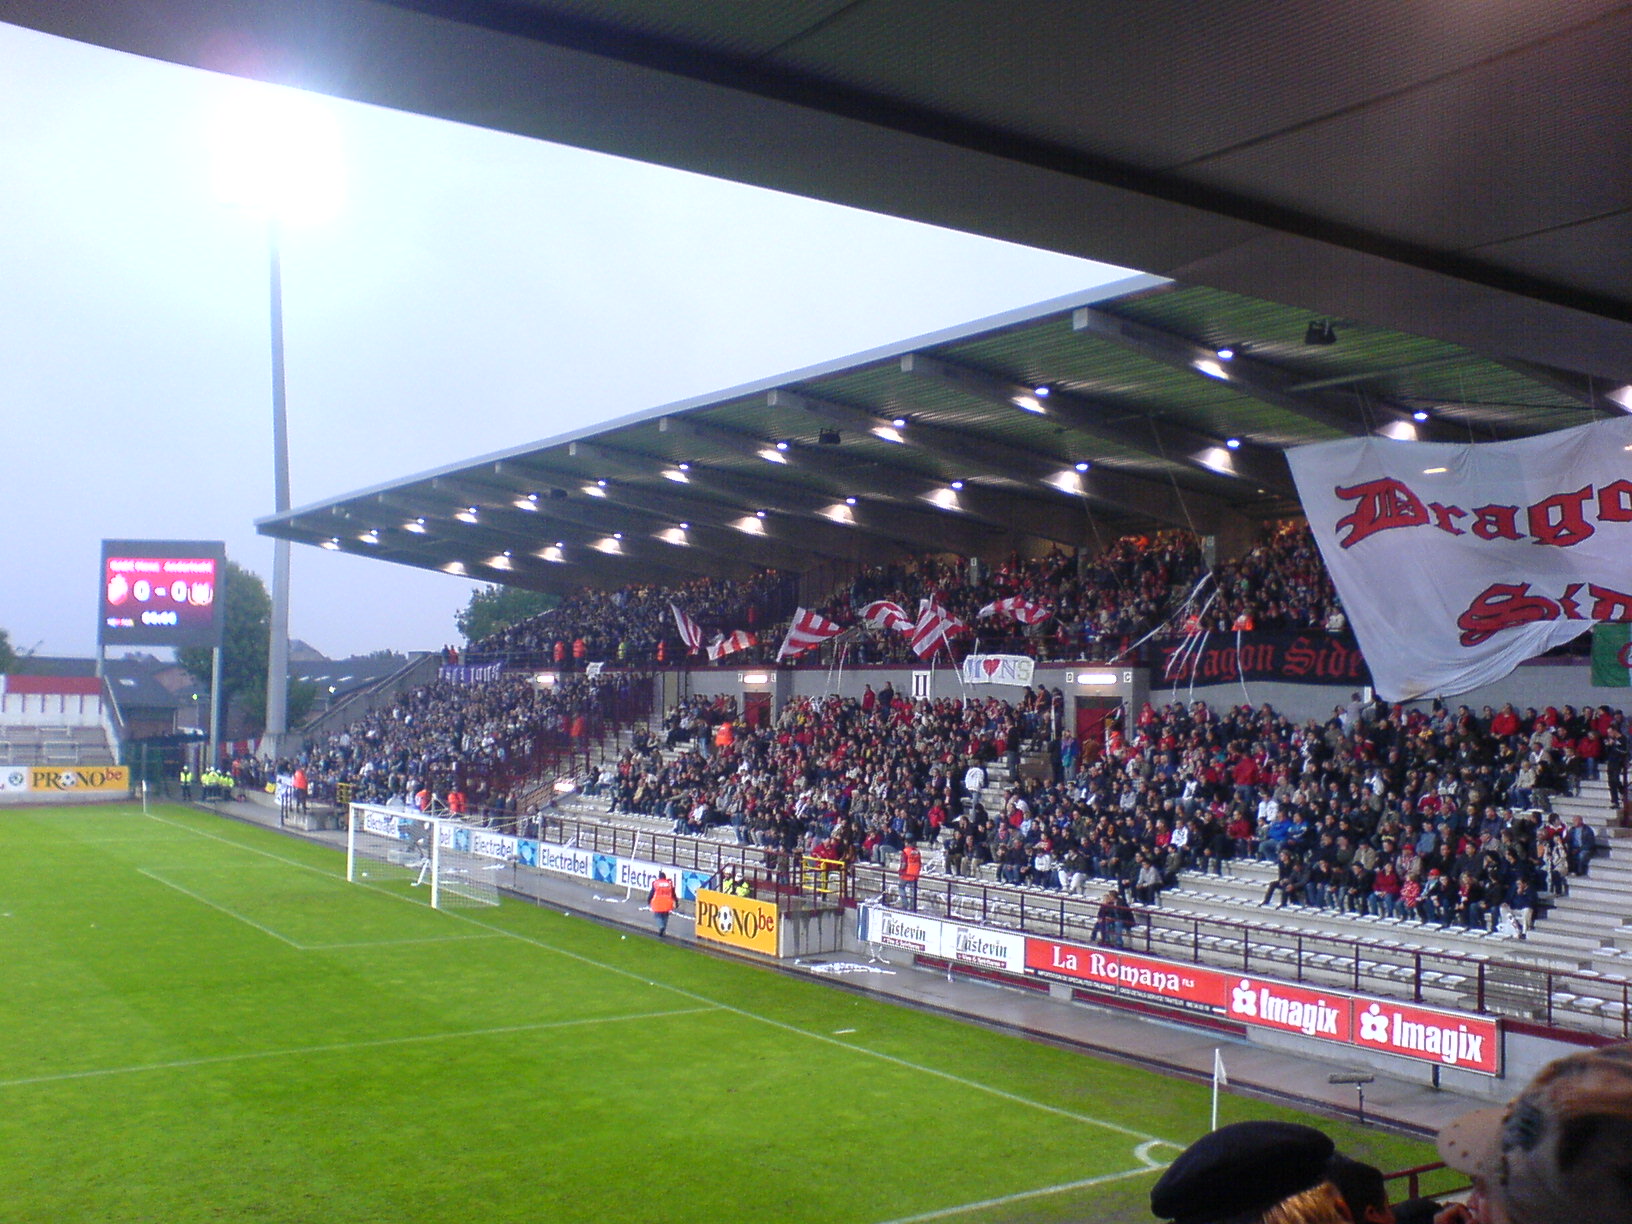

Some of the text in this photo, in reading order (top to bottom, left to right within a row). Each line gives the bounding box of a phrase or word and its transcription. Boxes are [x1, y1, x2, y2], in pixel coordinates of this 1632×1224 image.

[1161, 636, 1365, 681] Dragon Side
[474, 835, 514, 858] Electrabel
[542, 848, 589, 876] Electrabel
[621, 864, 677, 889] Electrl
[957, 929, 1007, 958] Tastevin
[1052, 946, 1077, 971] La
[1090, 953, 1179, 992] Romana
[1260, 989, 1338, 1035] Imagix
[1393, 1013, 1484, 1064] Imagix
